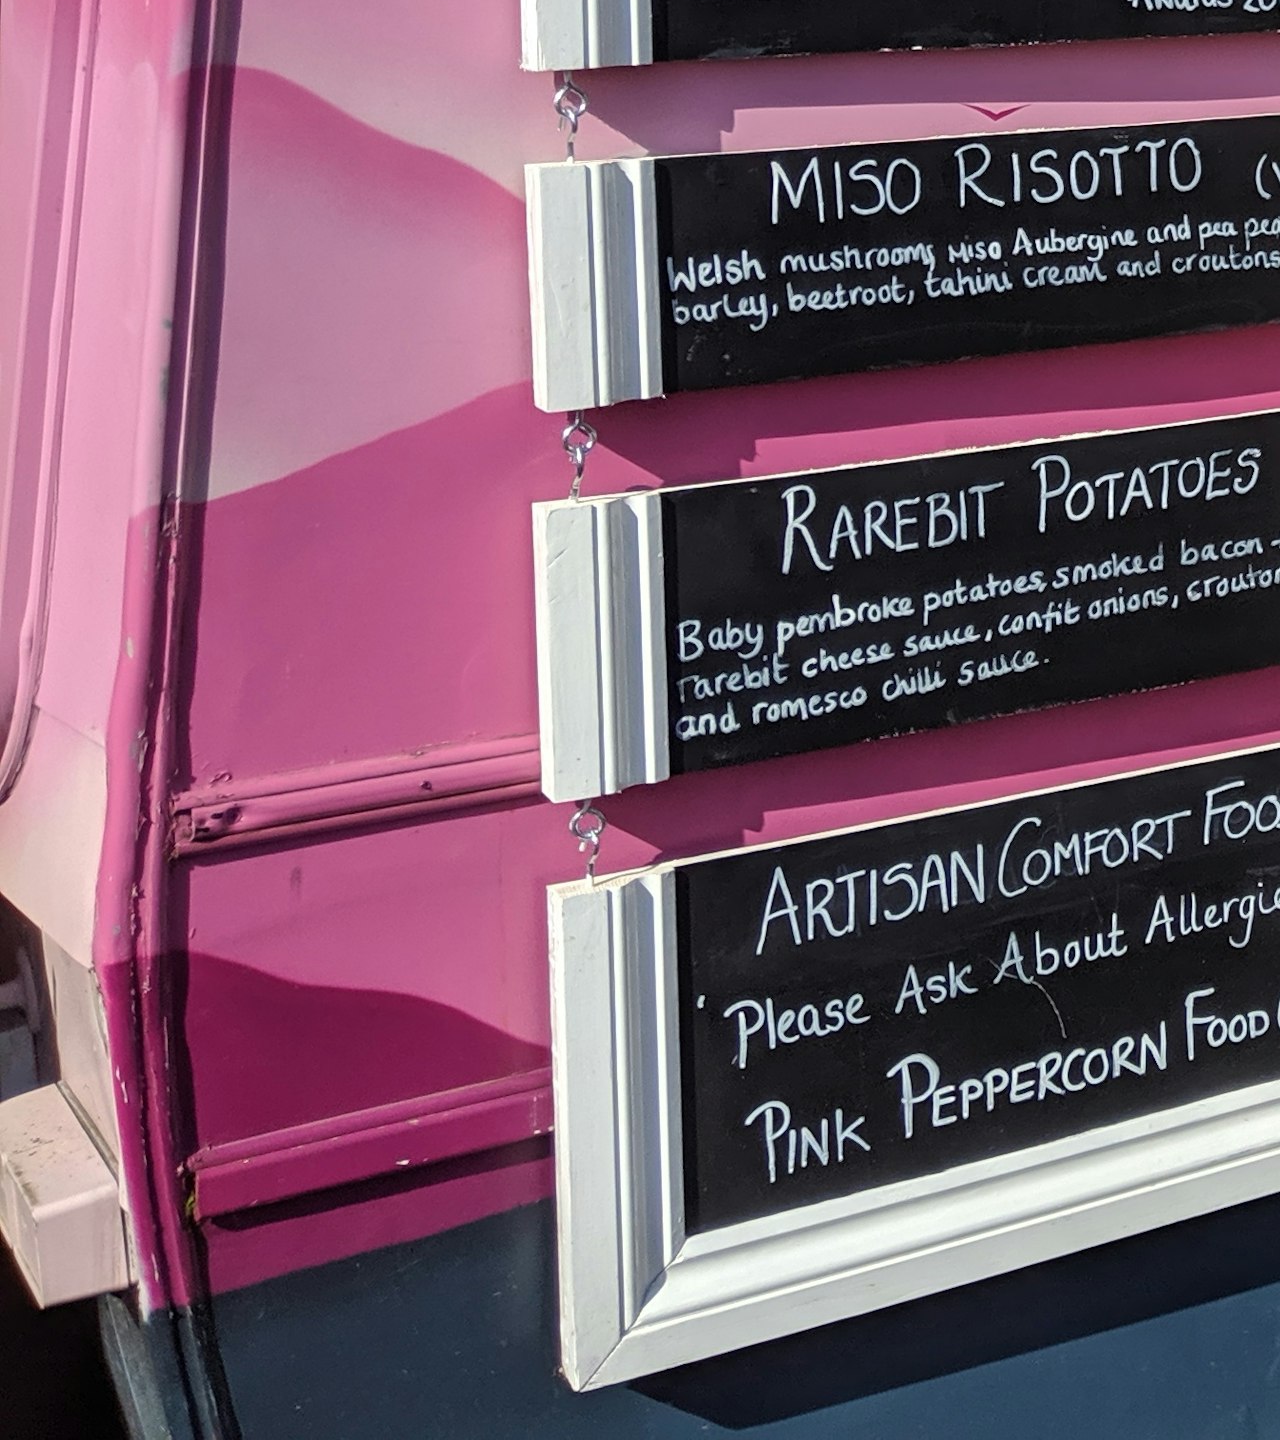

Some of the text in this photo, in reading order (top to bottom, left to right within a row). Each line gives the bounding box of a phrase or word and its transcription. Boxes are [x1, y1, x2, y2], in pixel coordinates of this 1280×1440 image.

[770, 156, 922, 225] MISO
[955, 138, 1202, 210] RISOTTO
[666, 253, 766, 292] Welsh
[1010, 223, 1138, 262] Aubergine
[1146, 213, 1192, 247] and
[1199, 218, 1236, 249] pea
[673, 288, 779, 331] barley,
[786, 276, 916, 313] beetroot,
[924, 262, 1013, 299] tahini
[1022, 259, 1106, 288] cream
[1117, 251, 1161, 278] and
[780, 447, 1261, 575] RAREBIT POTATOES
[676, 660, 789, 703] rarebit
[802, 640, 894, 675] cheese
[903, 623, 991, 658] sauce,
[998, 599, 1080, 637] confit
[1088, 588, 1179, 620] onions,
[678, 620, 765, 661] Baby
[777, 591, 913, 651] pembroke
[922, 571, 1045, 623] potatoes,
[1052, 545, 1163, 594] smoked
[1180, 530, 1263, 568] bacon
[676, 649, 1049, 741] and romesco chilli sauce.
[755, 843, 985, 957] ARTISAN
[998, 811, 1192, 899] COMFORT
[722, 994, 871, 1069] Please
[894, 960, 978, 1015] Ask
[994, 922, 1127, 986] About
[745, 1101, 871, 1184] PINK
[887, 1023, 1168, 1139] PEPPERCORN
[1184, 987, 1271, 1061] FOOD
